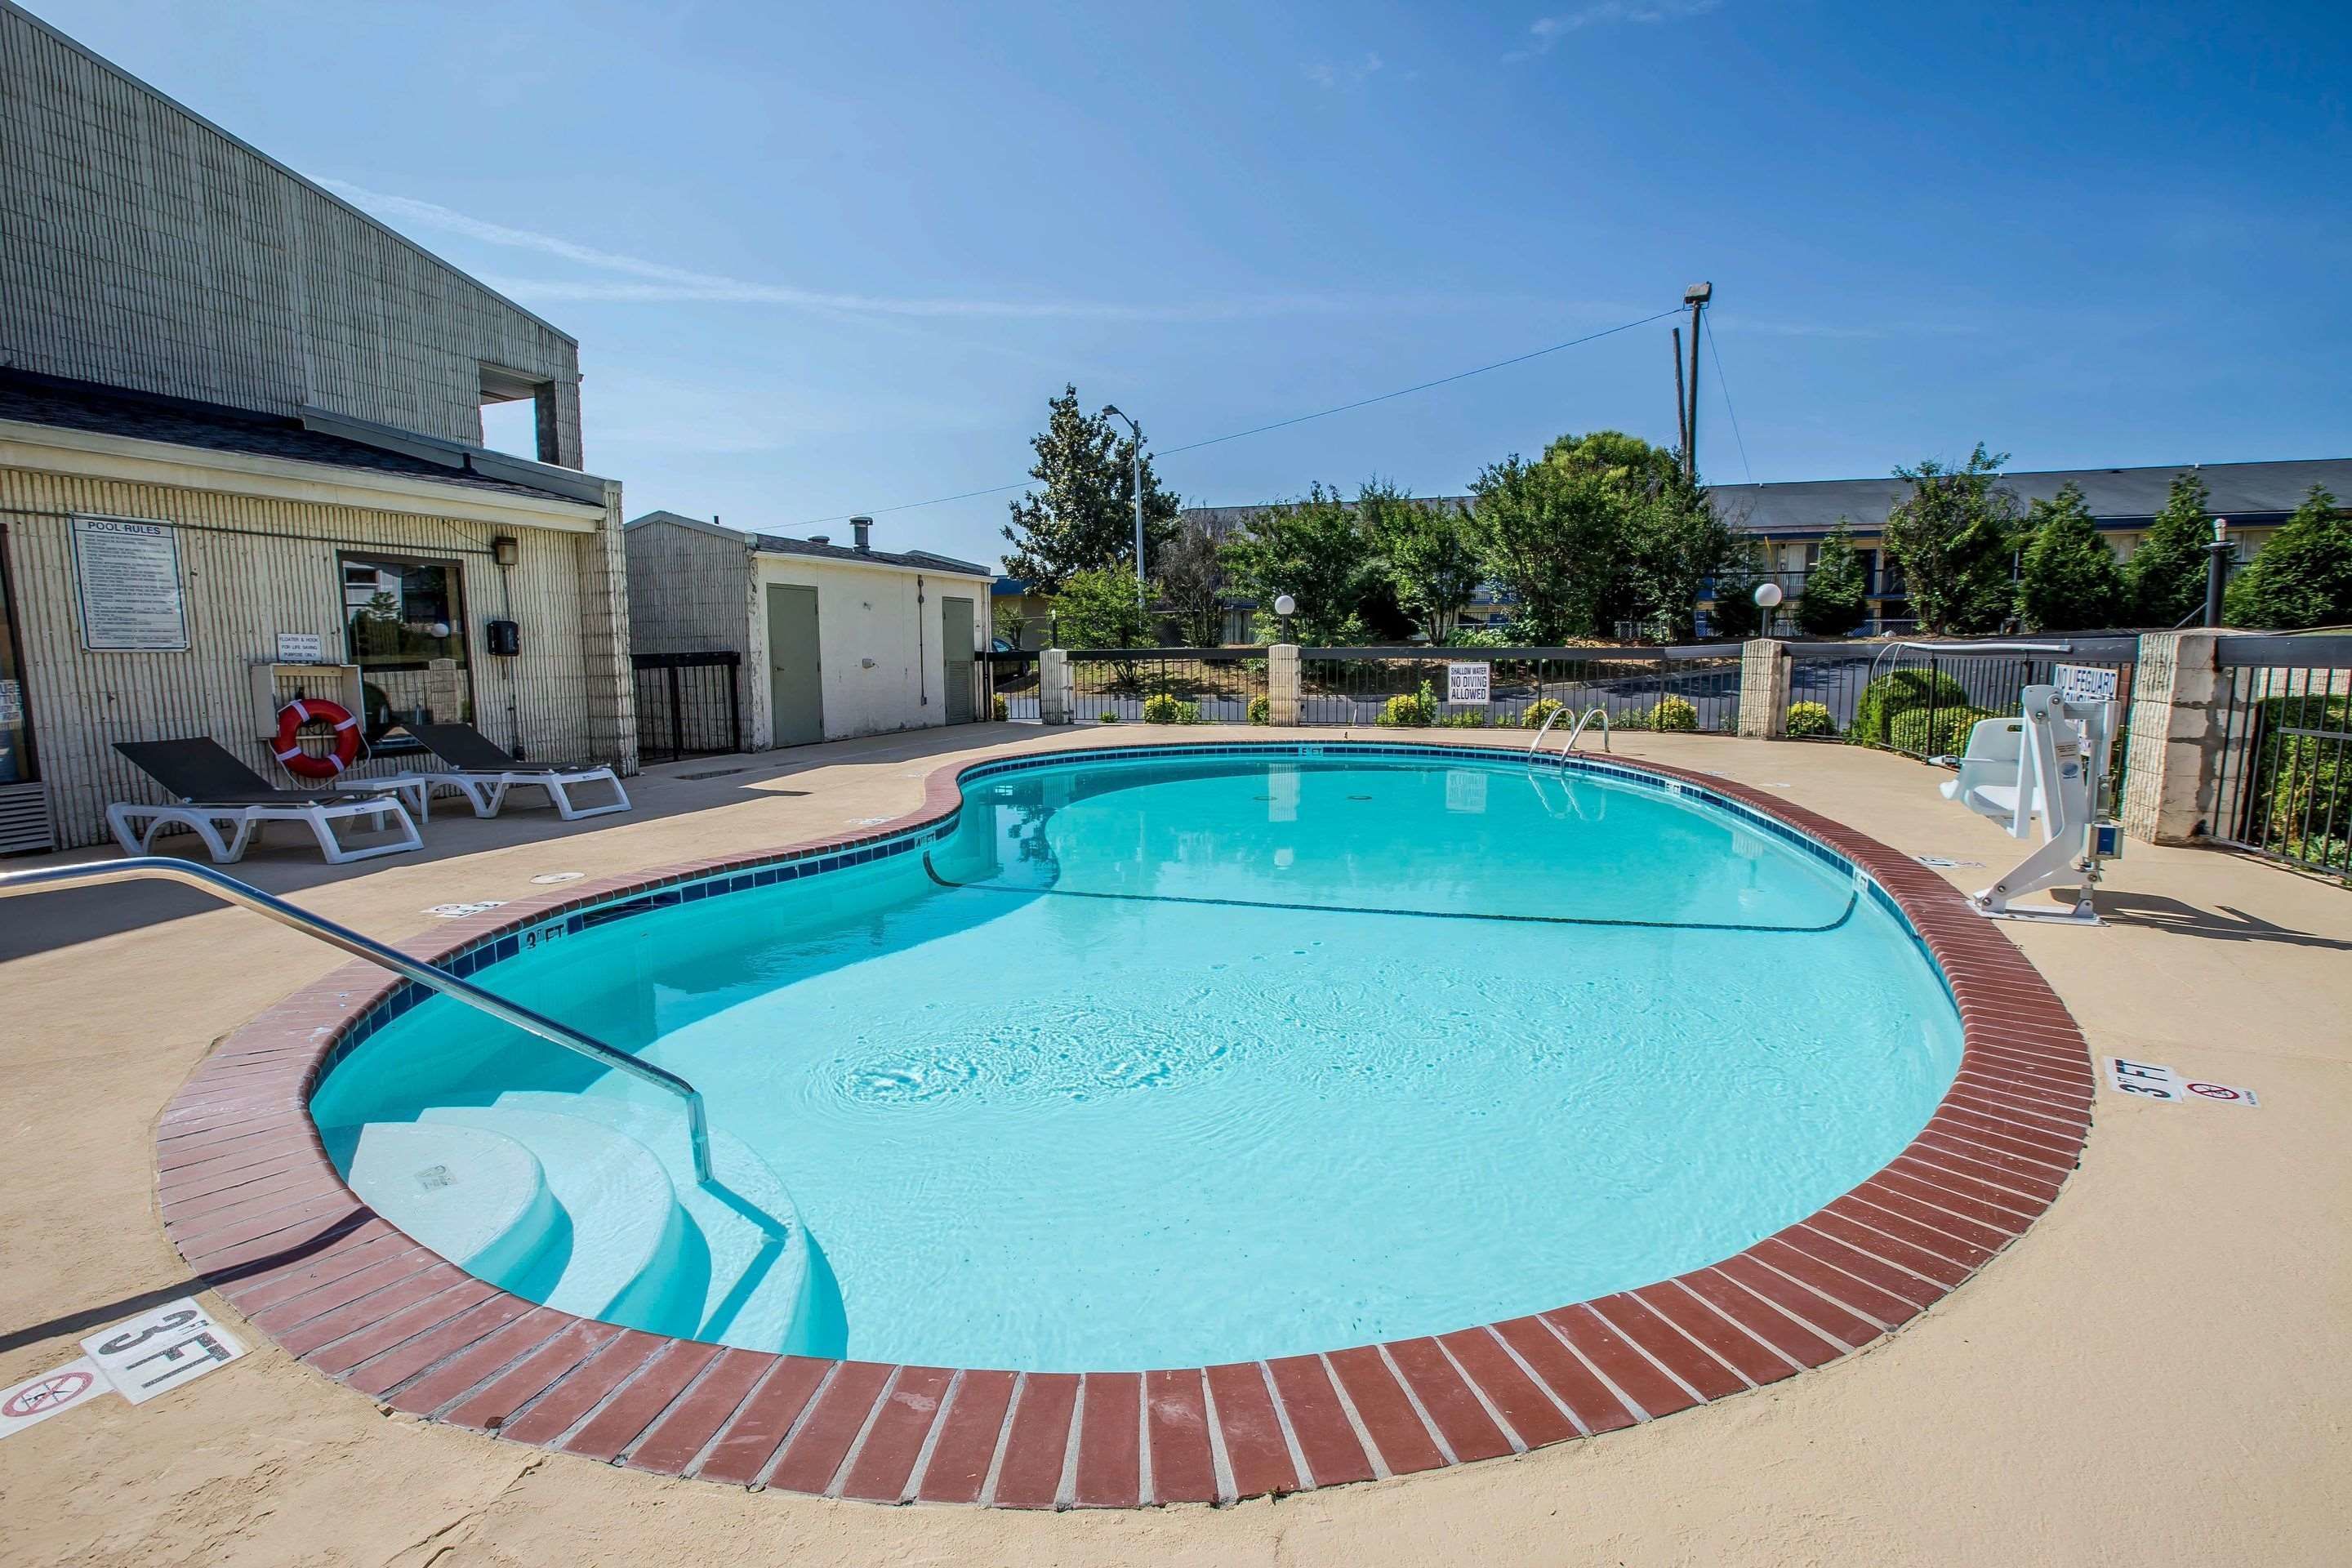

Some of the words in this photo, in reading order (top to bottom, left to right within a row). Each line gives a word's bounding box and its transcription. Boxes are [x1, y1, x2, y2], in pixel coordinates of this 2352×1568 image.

[88, 522, 122, 531] POOL
[124, 524, 161, 534] RULES
[1450, 667, 1471, 675] SHALLOW
[1472, 667, 1486, 675] WATER
[1451, 676, 1461, 688] NO
[1463, 676, 1487, 688] DIVING
[2068, 668, 2116, 696] LIFEGUARD
[1451, 688, 1486, 700] ALLOWED
[546, 924, 564, 942] FT
[2115, 1059, 2169, 1081] FT
[2118, 1084, 2172, 1098] 3
[98, 1309, 198, 1355] 3
[126, 1331, 232, 1389] FT
